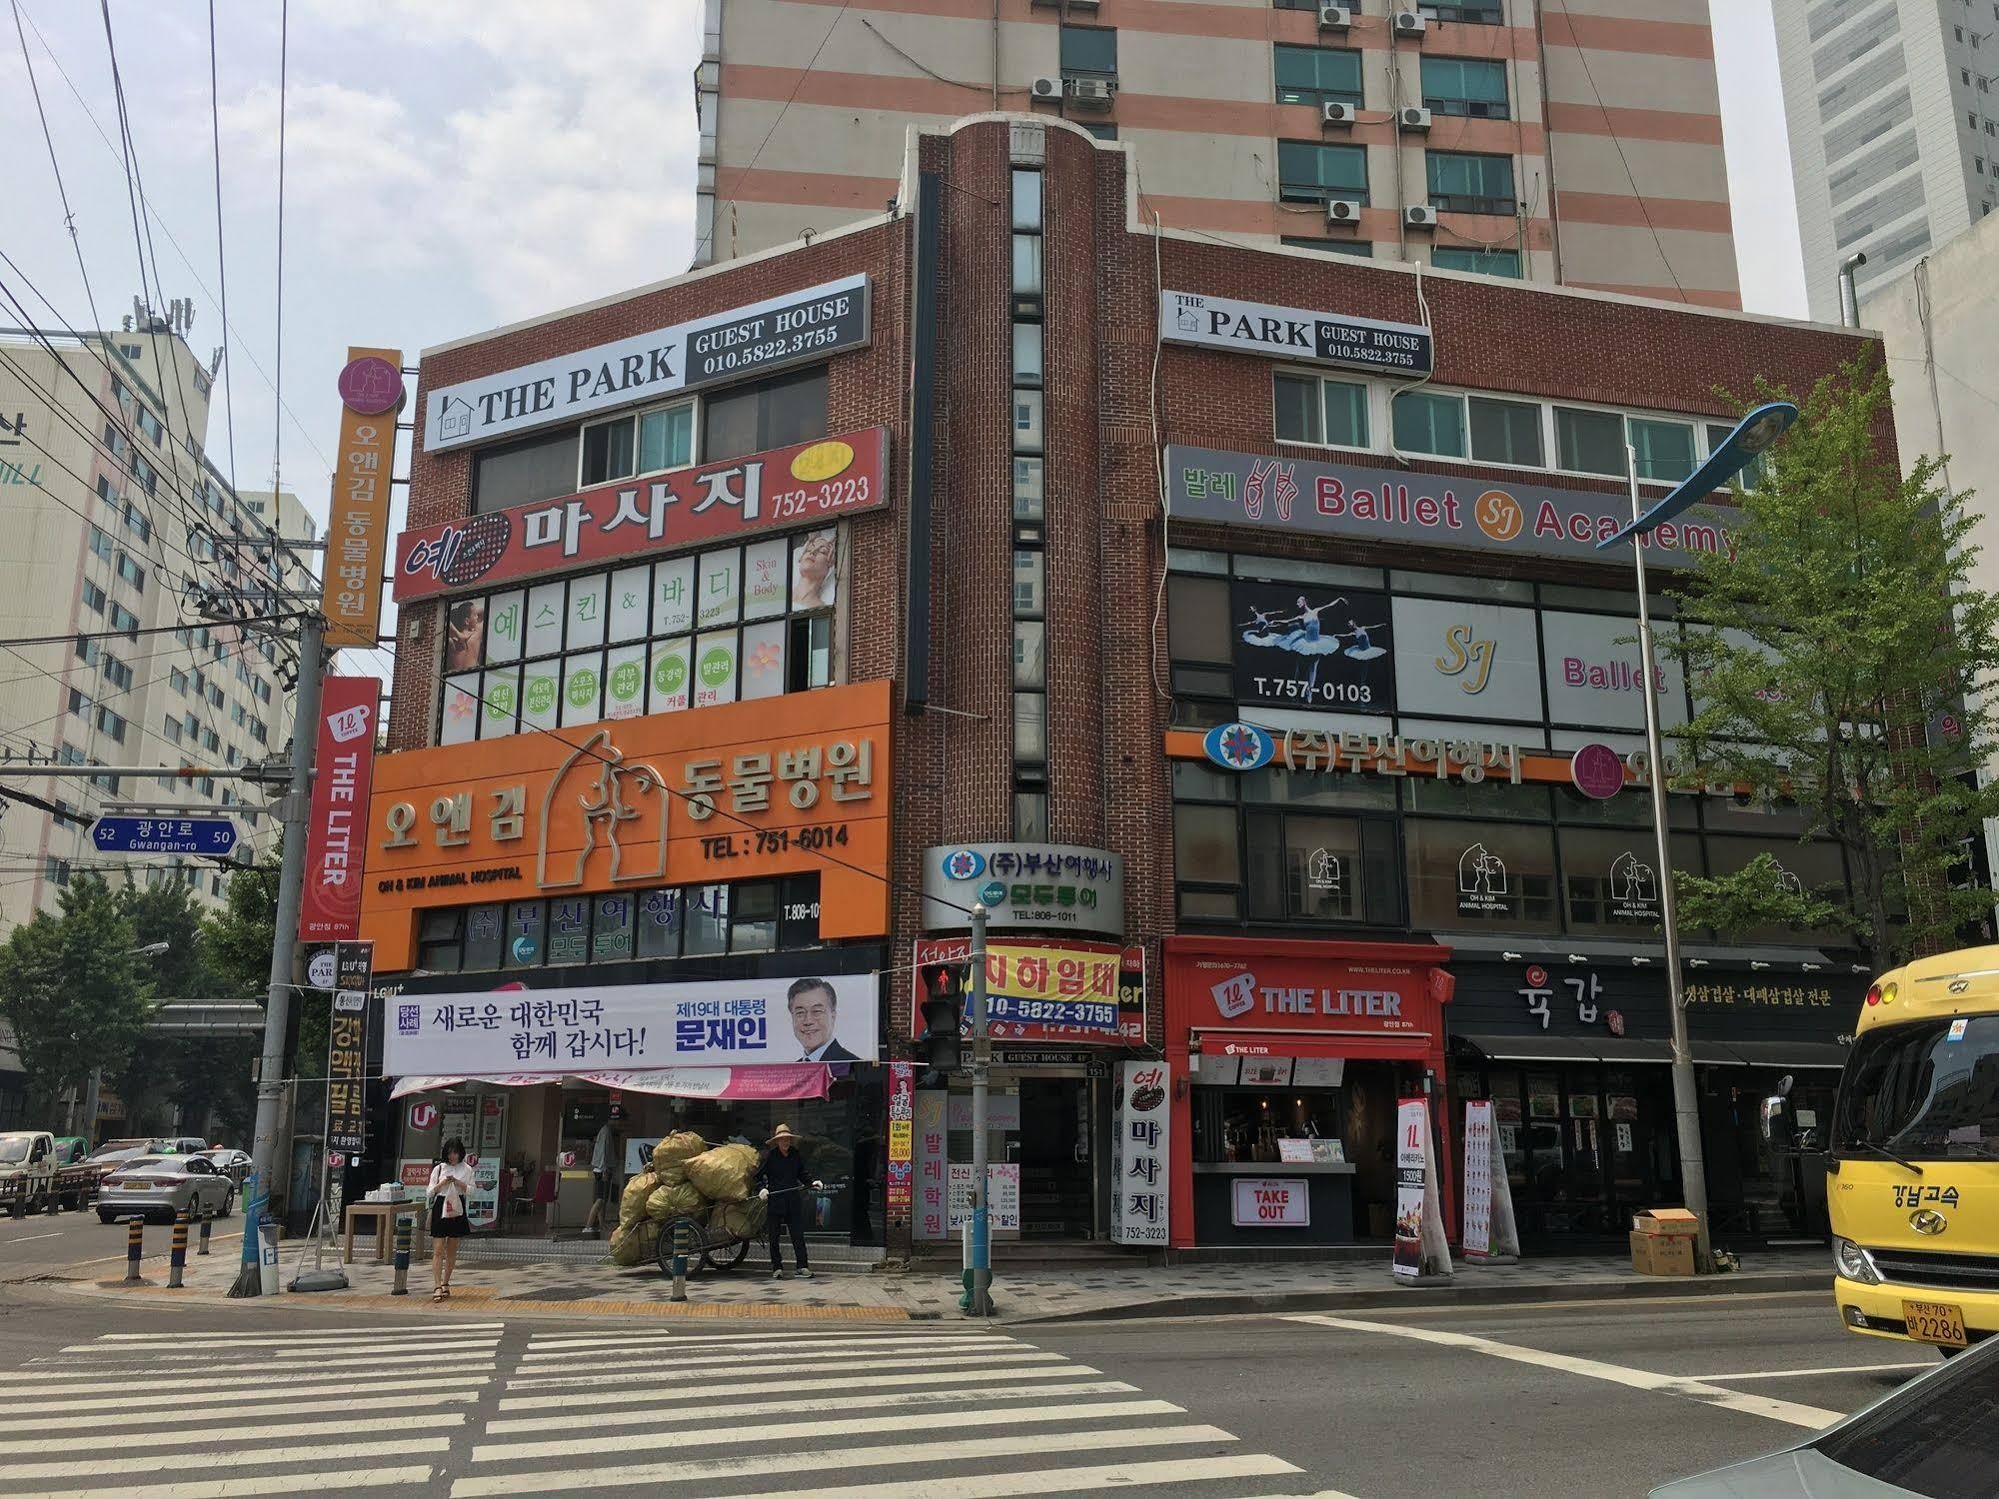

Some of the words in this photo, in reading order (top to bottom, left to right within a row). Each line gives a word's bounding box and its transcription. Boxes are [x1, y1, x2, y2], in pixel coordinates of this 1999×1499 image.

[1175, 294, 1204, 309] THE
[694, 320, 764, 355] GUEST
[775, 296, 851, 336] HOUSE
[1207, 310, 1313, 349] PARK
[1320, 325, 1366, 344] GUEST
[1373, 332, 1420, 352] HOUSE
[703, 325, 839, 376] 010.5822.3755
[1328, 343, 1414, 367] 010.5822.3755
[479, 377, 556, 426] THE
[567, 344, 679, 405] PARK
[772, 476, 870, 519] 752-3223
[1183, 467, 1237, 502] 발레
[524, 462, 764, 558] 마사지
[1315, 475, 1463, 531] Ballet
[335, 511, 373, 618] 동물병원
[756, 559, 777, 573] Skin
[754, 583, 777, 597] Body
[1253, 677, 1372, 703] T.757-0103
[1283, 727, 1525, 785] (주)부산여행사
[330, 752, 357, 802] THE
[380, 784, 526, 850] 오앤김
[681, 738, 873, 821] 동물병원
[99, 828, 115, 841] 52
[137, 821, 193, 838] 광안로
[213, 831, 230, 844] 50
[755, 825, 849, 856] 751-6014
[130, 839, 197, 852] Gwangan-ro
[322, 810, 352, 886] LITER
[428, 871, 468, 888] ANIMAL
[471, 866, 523, 885] HOSPITAL
[988, 852, 1112, 881] (주)부산여행사
[1010, 883, 1097, 911] 모두투어
[784, 902, 821, 921] T.808-10
[312, 968, 333, 977] PAR
[676, 1001, 720, 1018] 제19대
[724, 998, 767, 1016] 대통령
[986, 997, 1113, 1024] 10-5822-3755
[1260, 986, 1316, 1014] THE
[1322, 988, 1402, 1017] LITER
[1808, 988, 1832, 1007] 전문
[400, 1006, 418, 1017] 당선
[400, 1018, 418, 1029] 사례
[432, 1003, 502, 1032] 새로운
[510, 999, 605, 1029] 대한민국
[511, 1031, 558, 1060] 함께
[566, 1026, 646, 1059] 갑시다!
[676, 1017, 767, 1051] 문재인
[963, 1053, 1000, 1063] PK
[1008, 1053, 1038, 1062] GUEST
[1236, 1046, 1249, 1054] THE
[1250, 1046, 1269, 1054] LITER
[923, 1132, 942, 1235] 발레학원
[952, 1168, 970, 1180] 전신
[1128, 1119, 1161, 1223] 마사지
[1254, 1189, 1289, 1204] TAKE
[1892, 1185, 1959, 1209] 강남고속
[1258, 1205, 1286, 1219] OUT
[1125, 1226, 1167, 1241] 752-3223
[1916, 1303, 1931, 1315] 부산
[1932, 1305, 1947, 1317] 70
[1919, 1316, 1963, 1340] 2286
